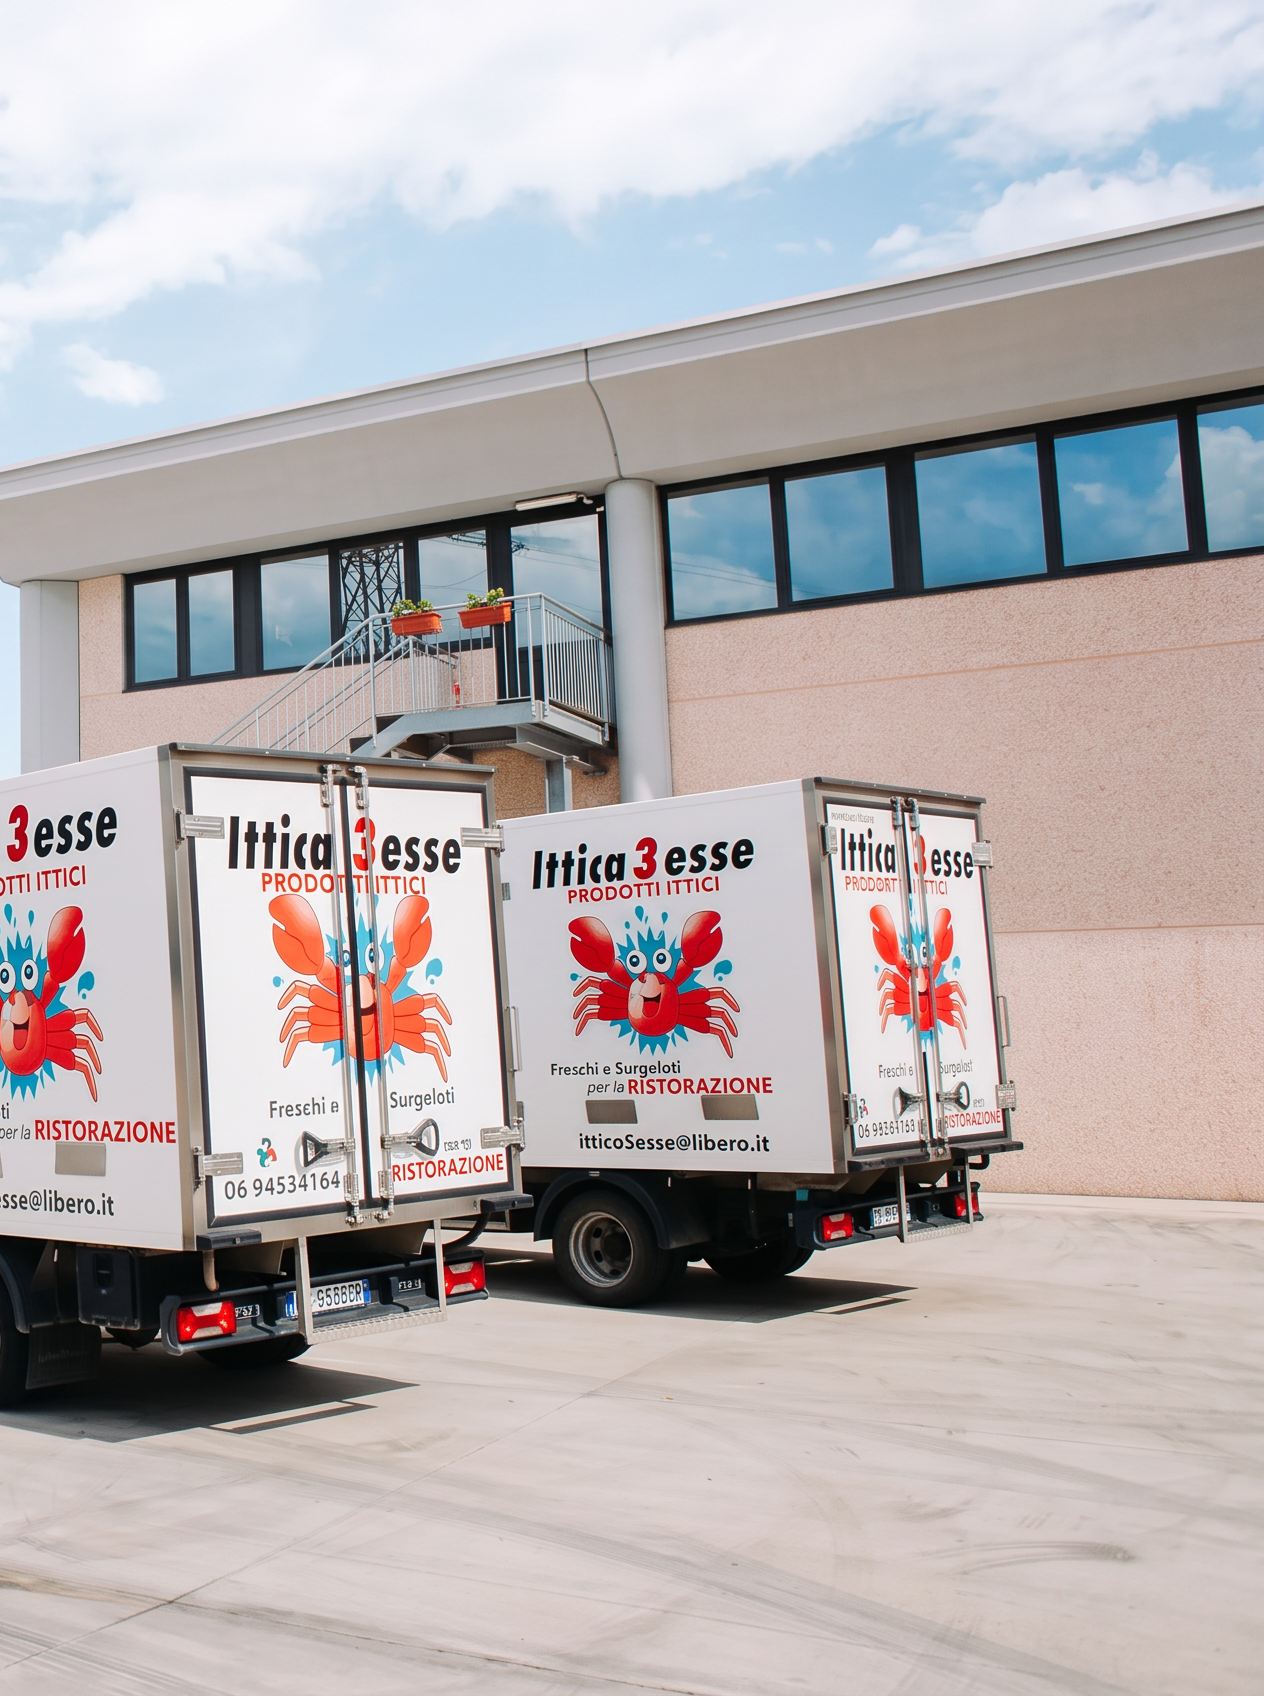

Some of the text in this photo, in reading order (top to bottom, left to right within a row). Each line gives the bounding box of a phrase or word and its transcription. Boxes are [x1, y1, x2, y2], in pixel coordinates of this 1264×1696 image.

[228, 813, 332, 870] Ittica
[841, 827, 896, 873] Ittica
[36, 865, 87, 891] ITTICI
[532, 843, 626, 889] Ittica
[375, 875, 425, 895] ITTICI
[567, 876, 720, 904] PRODOTTI ITTICI
[550, 1060, 681, 1078] Freschi e Surgeloti
[389, 1086, 455, 1111] Surgeloti
[587, 1077, 773, 1096] per la RISTORAZIONE
[269, 1096, 326, 1118] Freschi
[20, 1124, 31, 1140] la
[34, 1119, 177, 1144] RISTORAZIONE
[392, 1153, 504, 1182] RISTORAZIONE
[225, 1170, 341, 1200] 06 94534164
